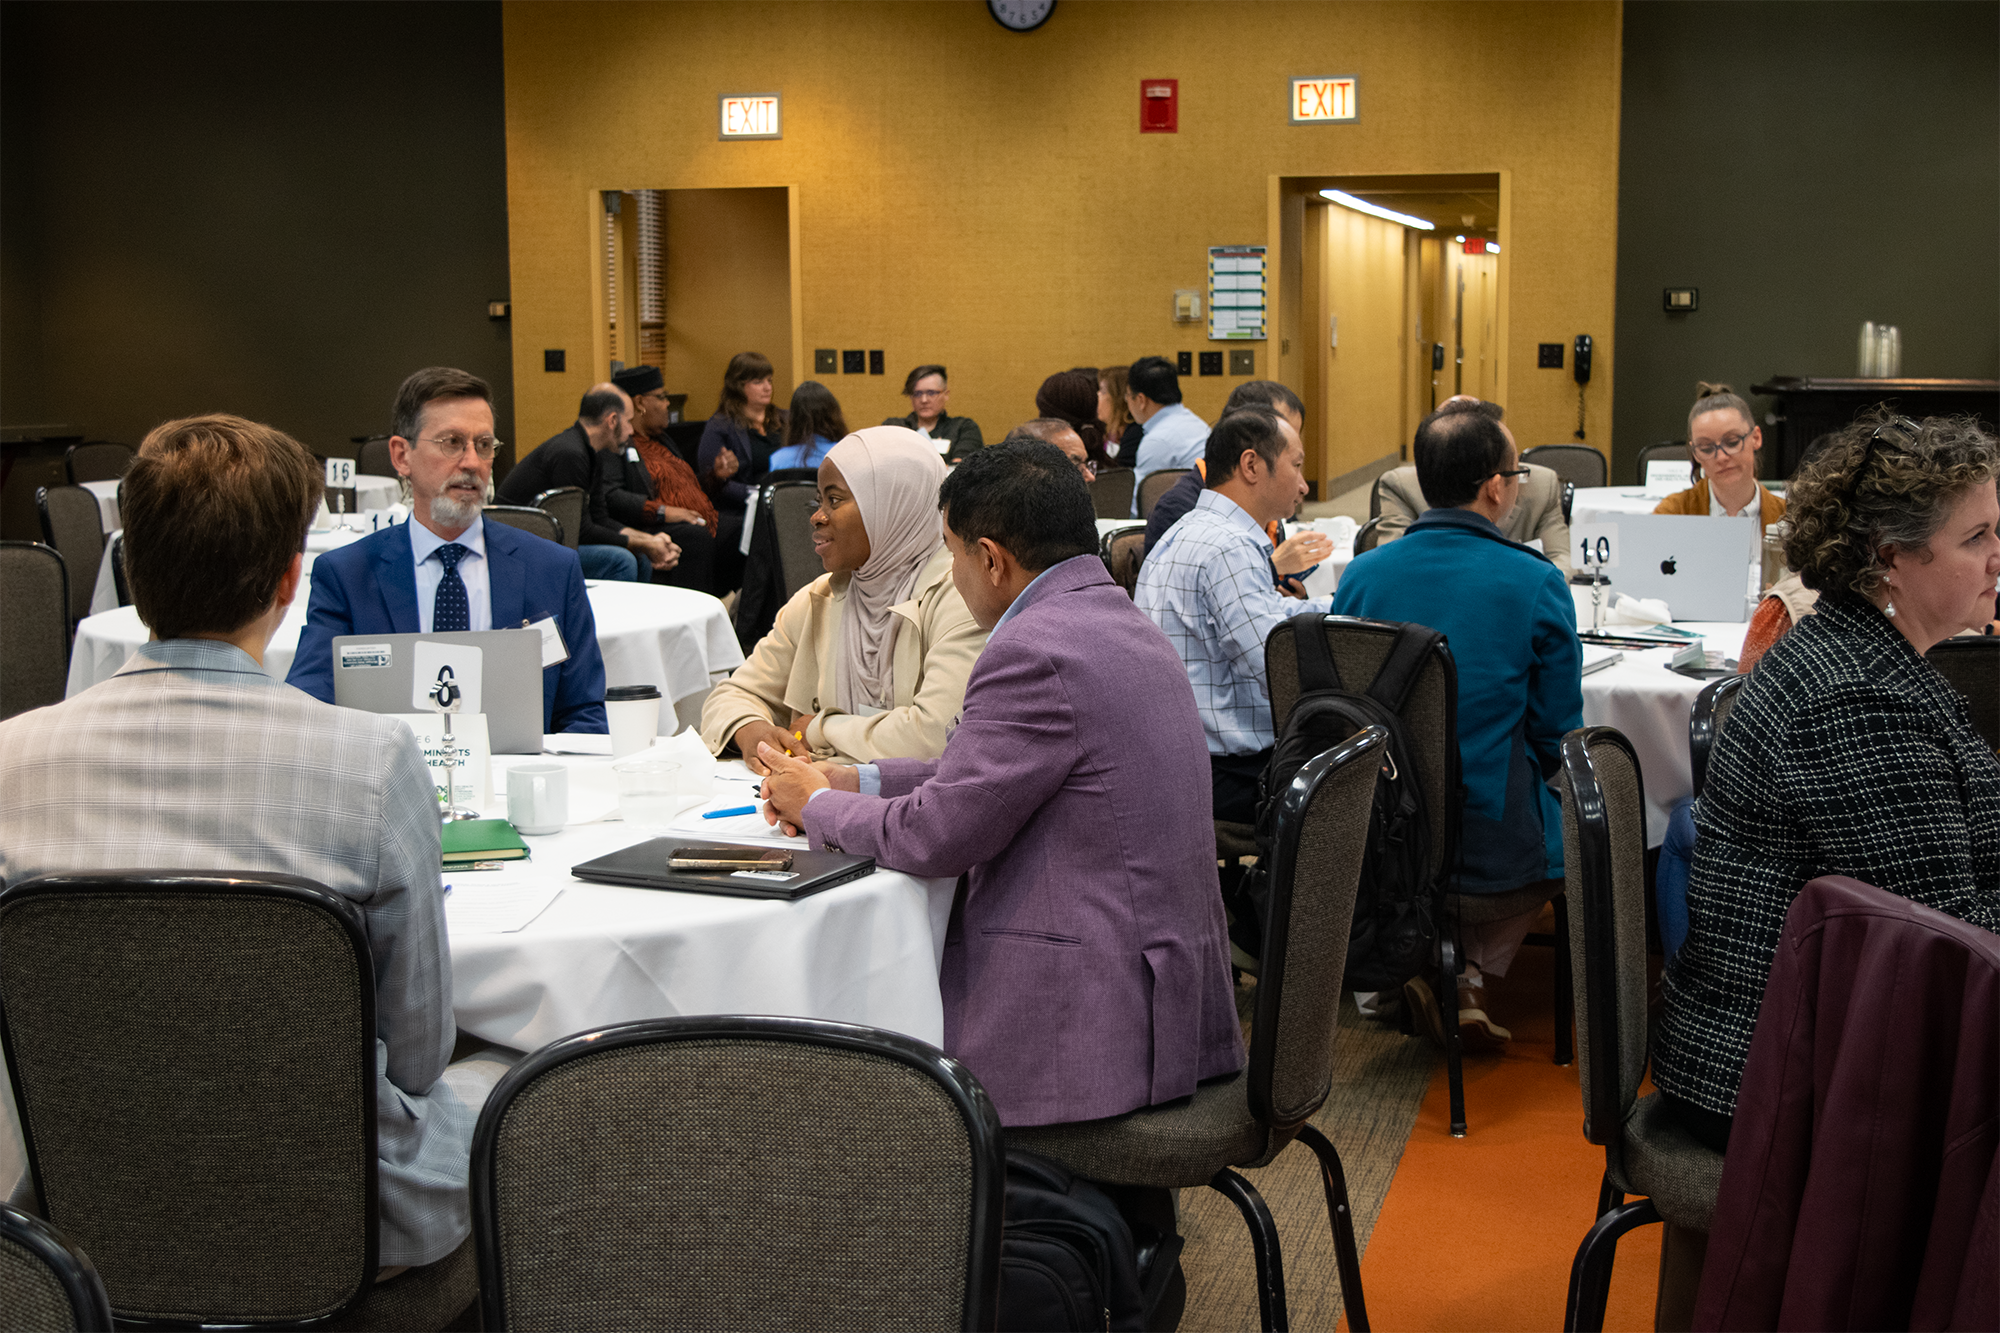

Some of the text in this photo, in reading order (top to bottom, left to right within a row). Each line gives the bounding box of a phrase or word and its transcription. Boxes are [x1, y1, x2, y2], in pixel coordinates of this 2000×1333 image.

[1299, 83, 1350, 117] EXIT
[728, 100, 774, 133] EXIT
[332, 462, 350, 481] 16
[1580, 536, 1610, 565] 10
[437, 664, 455, 708] 6
[425, 736, 431, 744] 6
